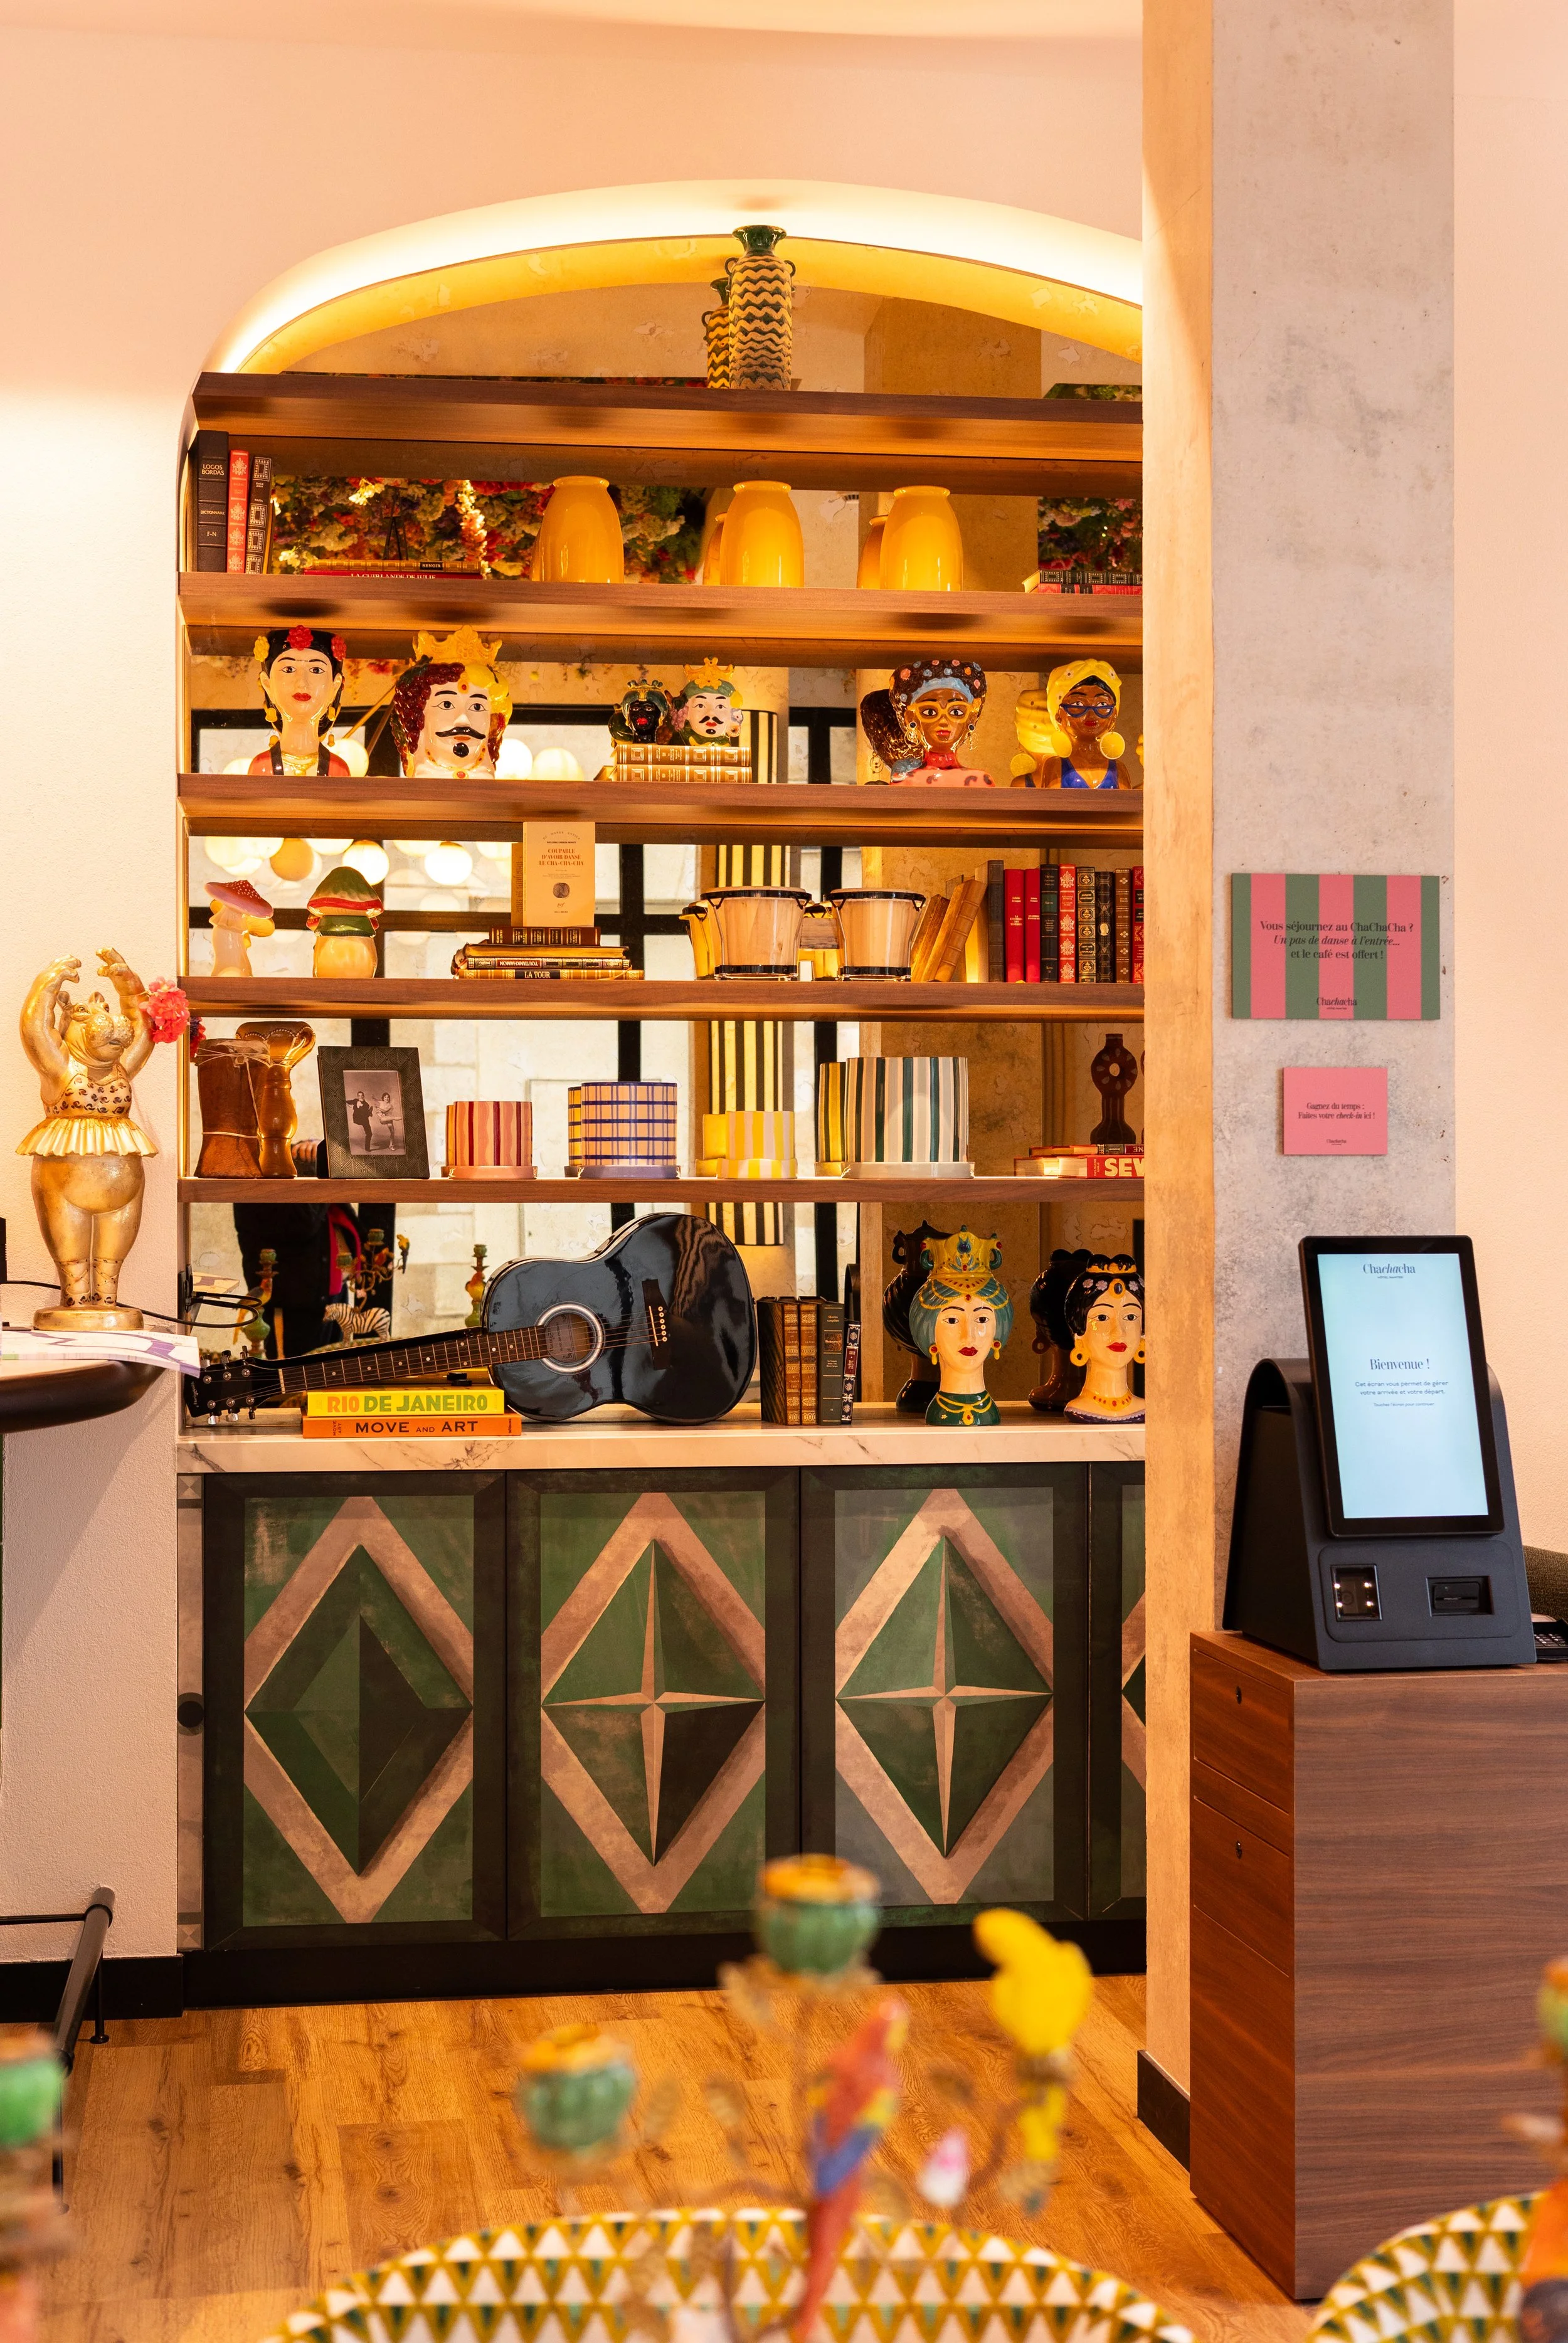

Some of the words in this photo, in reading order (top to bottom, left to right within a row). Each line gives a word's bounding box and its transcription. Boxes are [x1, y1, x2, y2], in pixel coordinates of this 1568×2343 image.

[1260, 921, 1284, 930] Vous
[1286, 921, 1333, 932] séjournez
[1350, 922, 1406, 932] ChaChaCha
[1409, 923, 1414, 932] ?
[1274, 935, 1286, 944] Un
[1289, 937, 1306, 946] pas
[1309, 935, 1319, 944] de
[1321, 936, 1349, 945] danse
[1351, 935, 1357, 945] à
[1360, 936, 1400, 946] l'entrée...
[1291, 949, 1299, 958] et
[1302, 949, 1310, 958] le
[1313, 949, 1333, 959] café
[1352, 950, 1378, 959] offert
[1380, 950, 1383, 959] !
[1316, 997, 1357, 1006] Chachacha
[1306, 1103, 1330, 1111] Gagnez
[1363, 1263, 1416, 1274] Chachacha
[1370, 1358, 1423, 1370] Bienvenue
[1426, 1358, 1430, 1369] !
[327, 1396, 360, 1413] RIO
[364, 1395, 392, 1412] DE
[396, 1394, 488, 1412] JANEIRO
[356, 1422, 410, 1433] MOVE
[441, 1420, 478, 1432] ART
